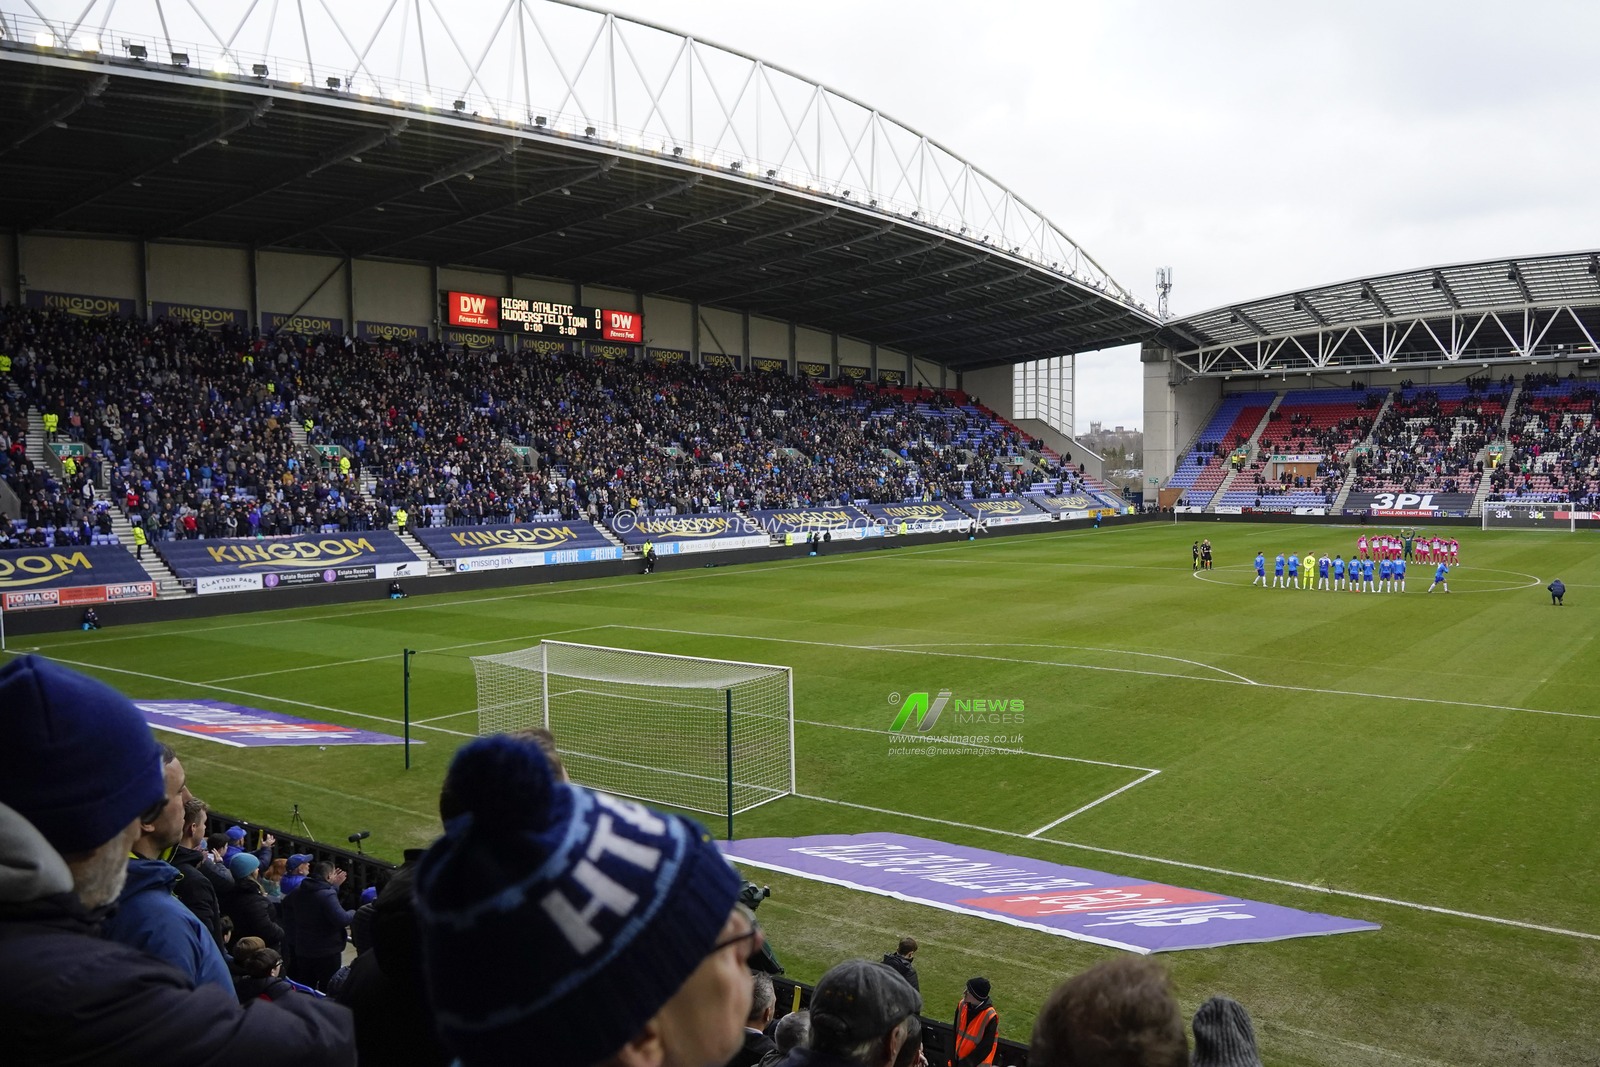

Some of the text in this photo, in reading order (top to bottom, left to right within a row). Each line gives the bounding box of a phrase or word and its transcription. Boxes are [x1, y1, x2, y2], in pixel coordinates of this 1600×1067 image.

[44, 295, 119, 313] KINGDOM
[460, 295, 486, 314] DW
[501, 297, 528, 311] WIGAN
[532, 301, 573, 316] ATHLETIC
[168, 306, 234, 322] KINGDOM
[501, 309, 564, 326] HUDDERSFIELD
[567, 316, 588, 329] TOWN
[611, 313, 632, 329] DW
[366, 324, 417, 338] KINGDOM
[524, 322, 577, 336] 0:00 3:00
[450, 332, 495, 345] KINGDOM
[523, 339, 565, 351] KINGDOM
[590, 345, 627, 357] KINGDOM
[649, 350, 683, 360] KINGDOM
[971, 500, 1026, 511] KINGDOM
[1370, 493, 1439, 510] 3PL
[773, 511, 852, 524] KINGDOM
[882, 505, 948, 517] KINGDOM
[1495, 510, 1512, 519] 3PL
[451, 526, 577, 546] KINGDOM
[207, 538, 376, 563] KINGDOM
[551, 551, 579, 563] #BELIEVE
[590, 549, 617, 561] #BELIEVE
[471, 558, 499, 568] missing
[501, 556, 513, 566] link
[201, 577, 257, 589] CLAYTON PARK
